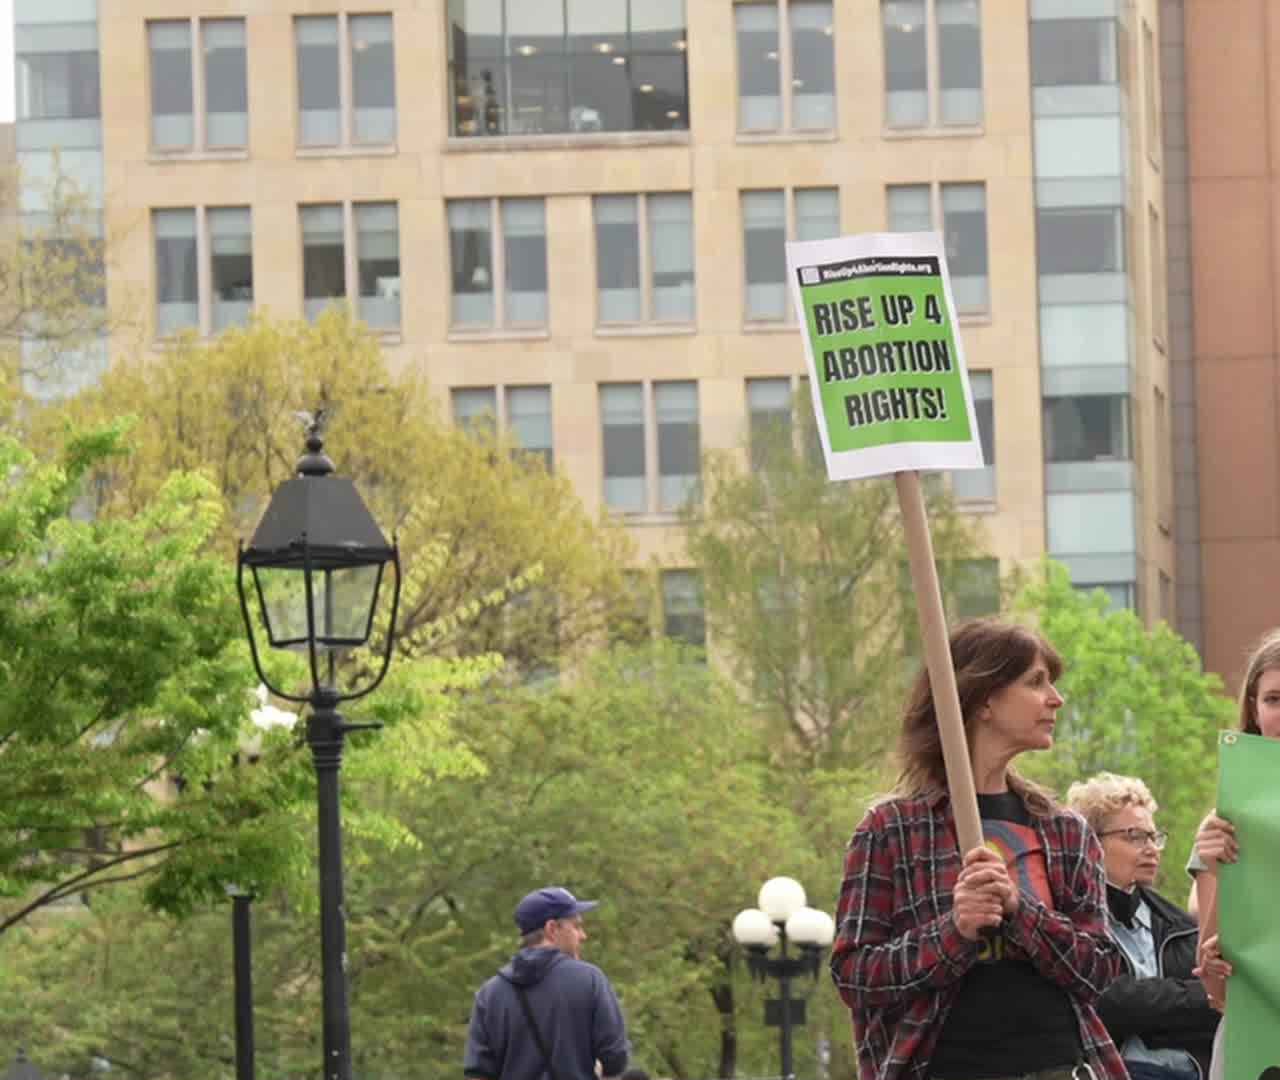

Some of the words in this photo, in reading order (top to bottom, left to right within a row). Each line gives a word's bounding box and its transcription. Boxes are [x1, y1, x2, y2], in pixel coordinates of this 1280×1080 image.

[813, 297, 875, 336] RISE
[881, 294, 914, 327] UP
[925, 294, 942, 325] 4
[823, 340, 952, 383] ABORTION
[844, 388, 947, 427] RIGHTS!
